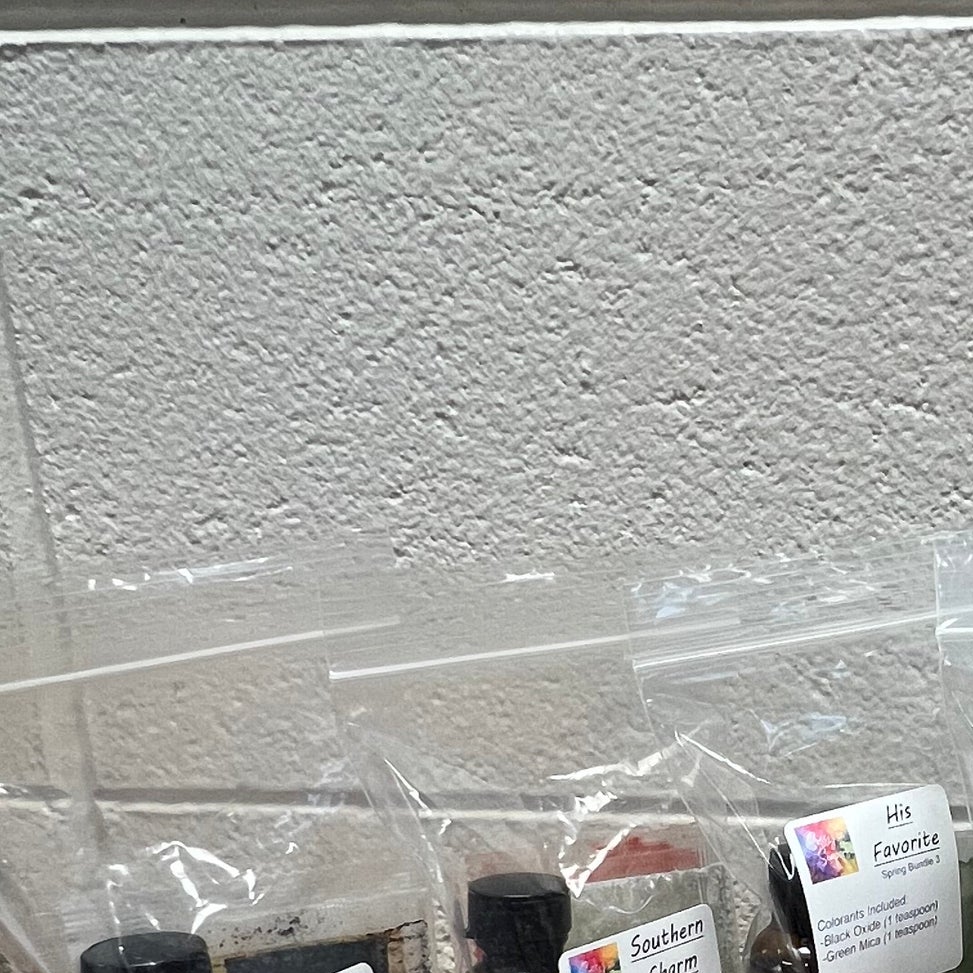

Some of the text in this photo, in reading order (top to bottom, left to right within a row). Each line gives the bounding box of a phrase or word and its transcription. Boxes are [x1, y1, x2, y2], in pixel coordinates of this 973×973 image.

[886, 803, 912, 824] His
[873, 830, 940, 862] Favorite
[881, 854, 941, 880] Spring Bundle 3
[817, 909, 865, 932] Colorants
[820, 899, 939, 948] -Black Oxide (1 teaspoon)
[630, 918, 704, 957] Southern
[822, 914, 938, 962] -Green Mica (1 teaspoon)
